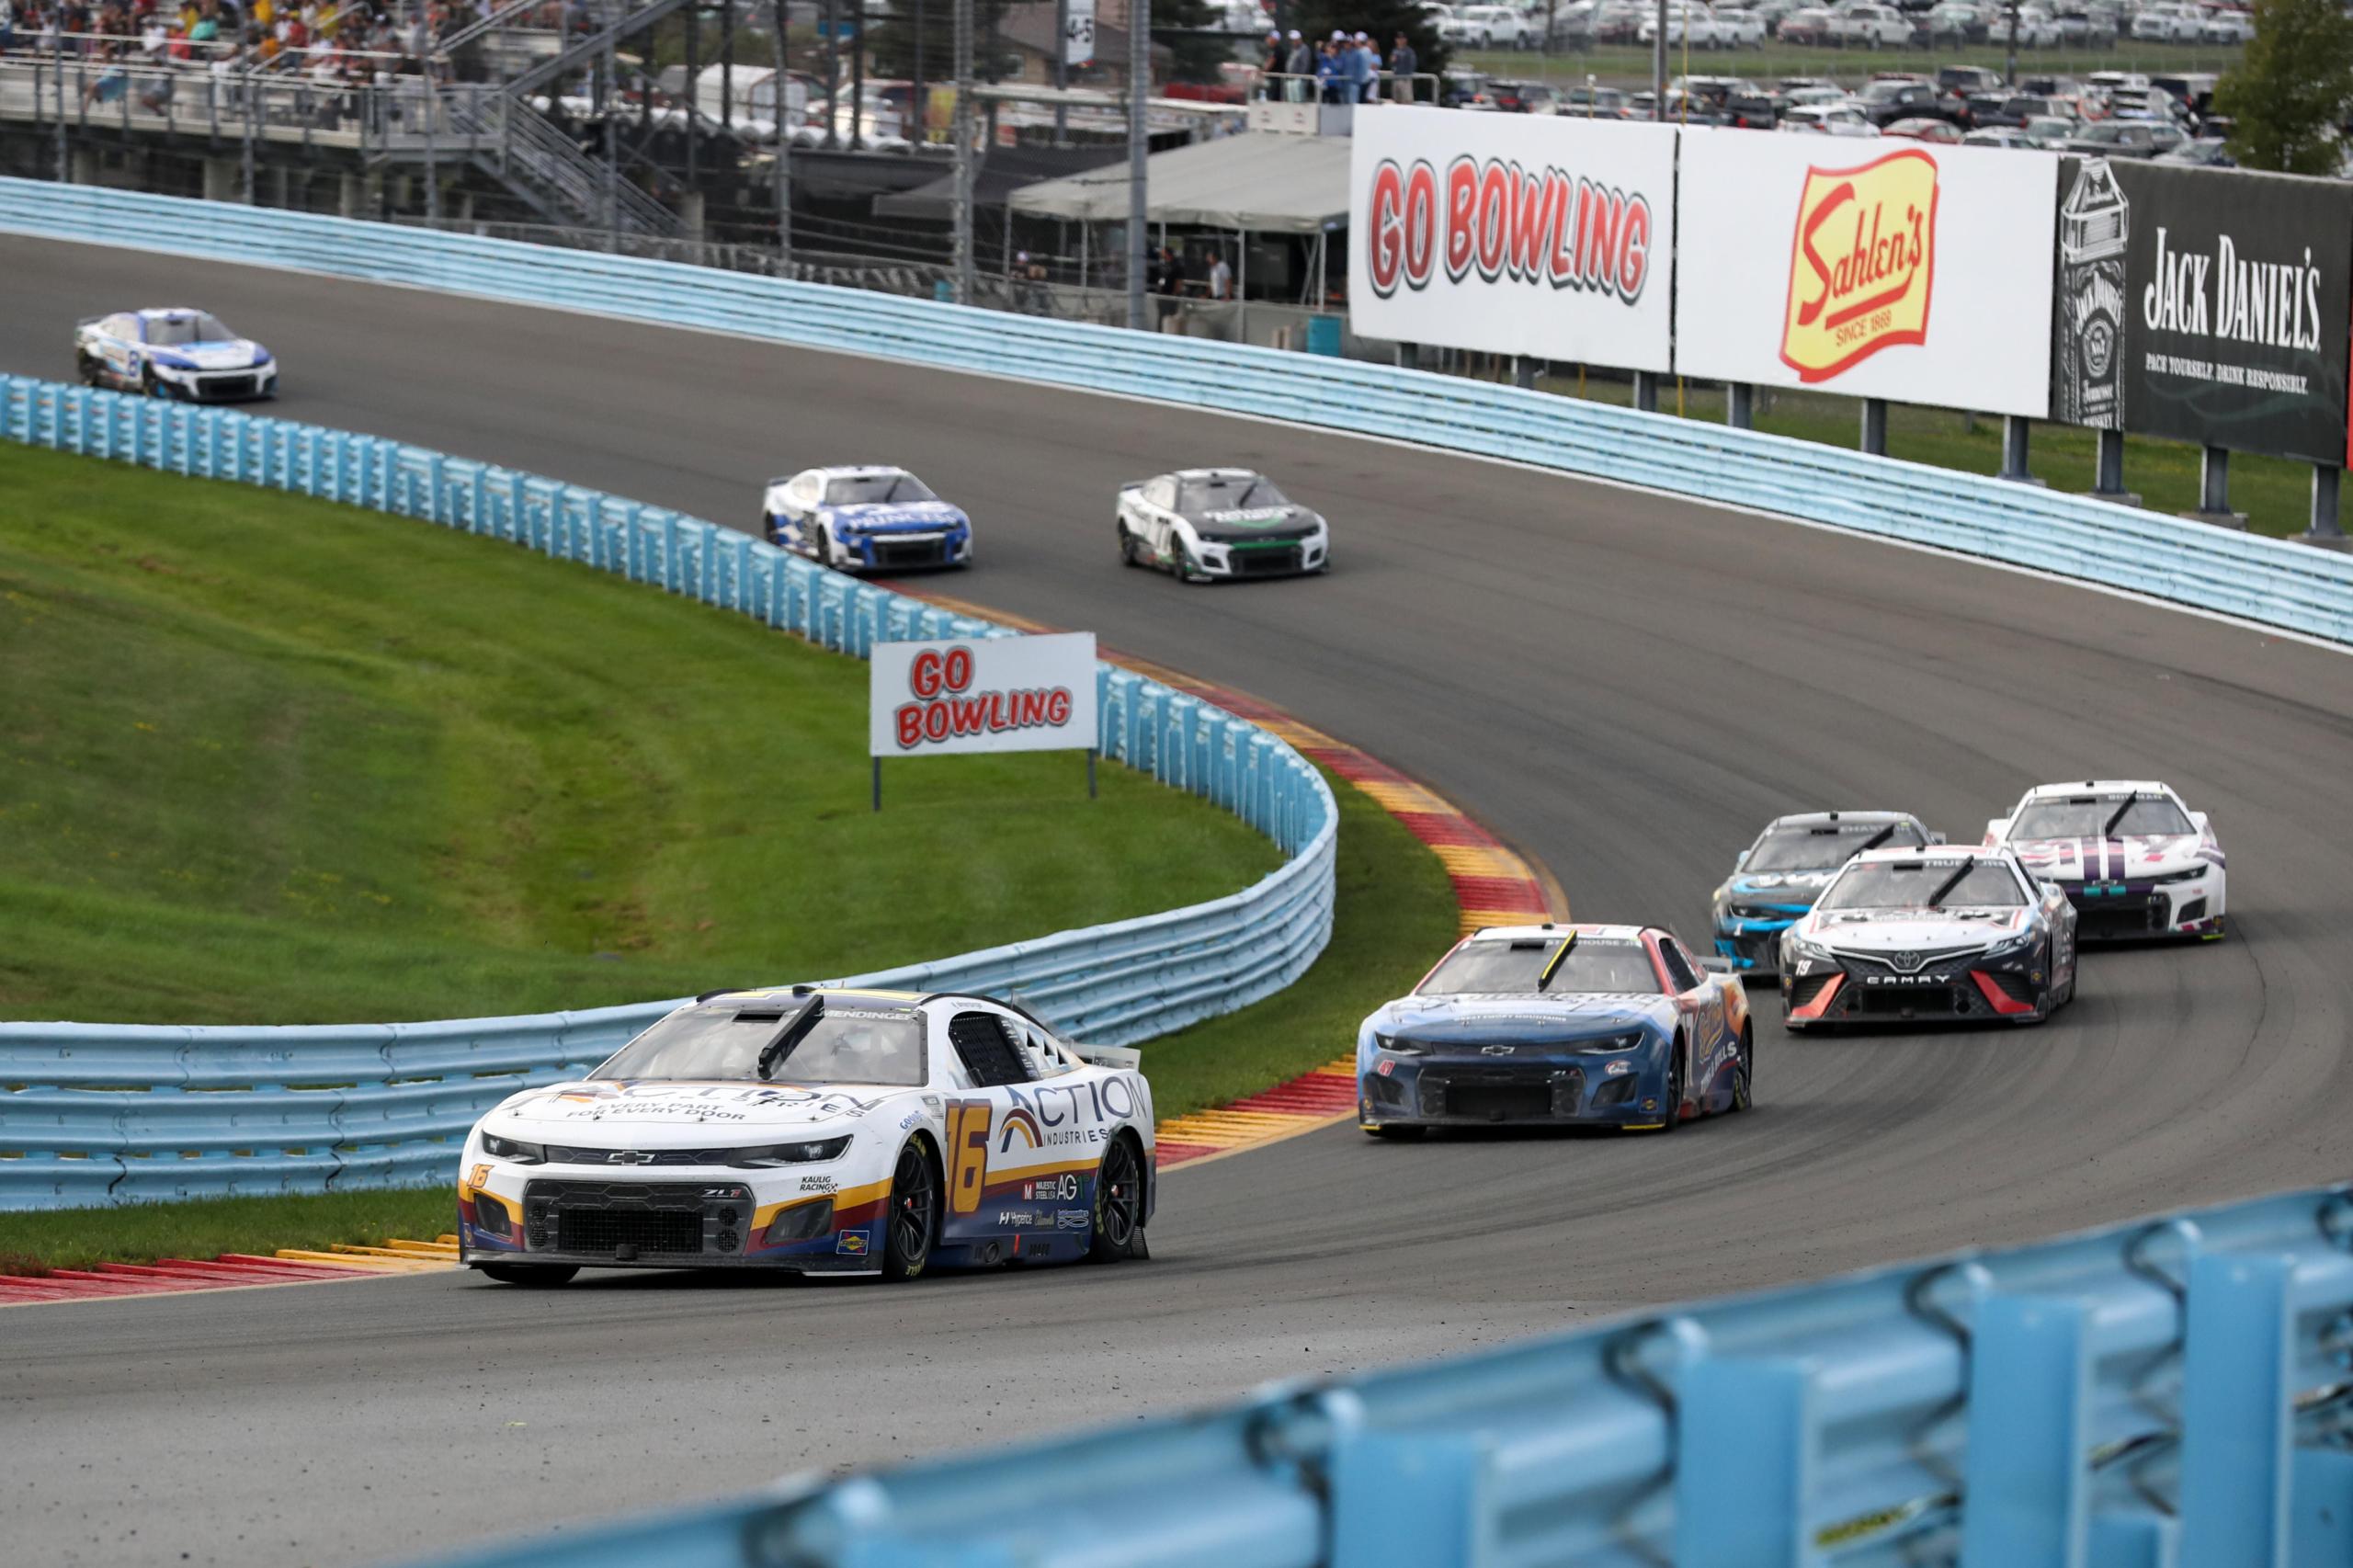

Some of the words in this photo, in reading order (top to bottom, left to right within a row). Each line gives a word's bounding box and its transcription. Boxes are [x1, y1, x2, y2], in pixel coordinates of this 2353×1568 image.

[1370, 157, 1439, 301] GO
[1446, 153, 1653, 307] BOWLING
[1797, 182, 1924, 326] Sahlen's
[2143, 226, 2211, 336] JACK
[2215, 233, 2321, 353] DANIEL'S
[1836, 323, 1867, 347] SINCE
[2145, 352, 2167, 372] PACE
[2168, 356, 2215, 381] YOURSELF.
[2216, 363, 2245, 385] DRINK
[2246, 368, 2309, 395] RESPONSIBLY.
[909, 645, 975, 700] GO
[895, 686, 1074, 749] BOWLING
[1839, 825, 1915, 835] CHASTIN
[1546, 938, 1620, 947] STHOUSE
[1795, 959, 1813, 977] 19
[1866, 974, 1950, 986] CAMRY
[1378, 1059, 1396, 1077] 47
[566, 1109, 607, 1119] FOR
[684, 1108, 746, 1120] DOOR
[596, 1102, 661, 1110] EVERY
[667, 1102, 725, 1111] PART
[998, 1076, 1147, 1153] ACTION
[1043, 1128, 1110, 1147] INDUSTRIES
[943, 1097, 993, 1219] 16
[466, 1163, 496, 1188] 16
[801, 1176, 832, 1184] KAULIG
[799, 1183, 831, 1192] RACING
[1036, 1181, 1057, 1190] MAJESTIC
